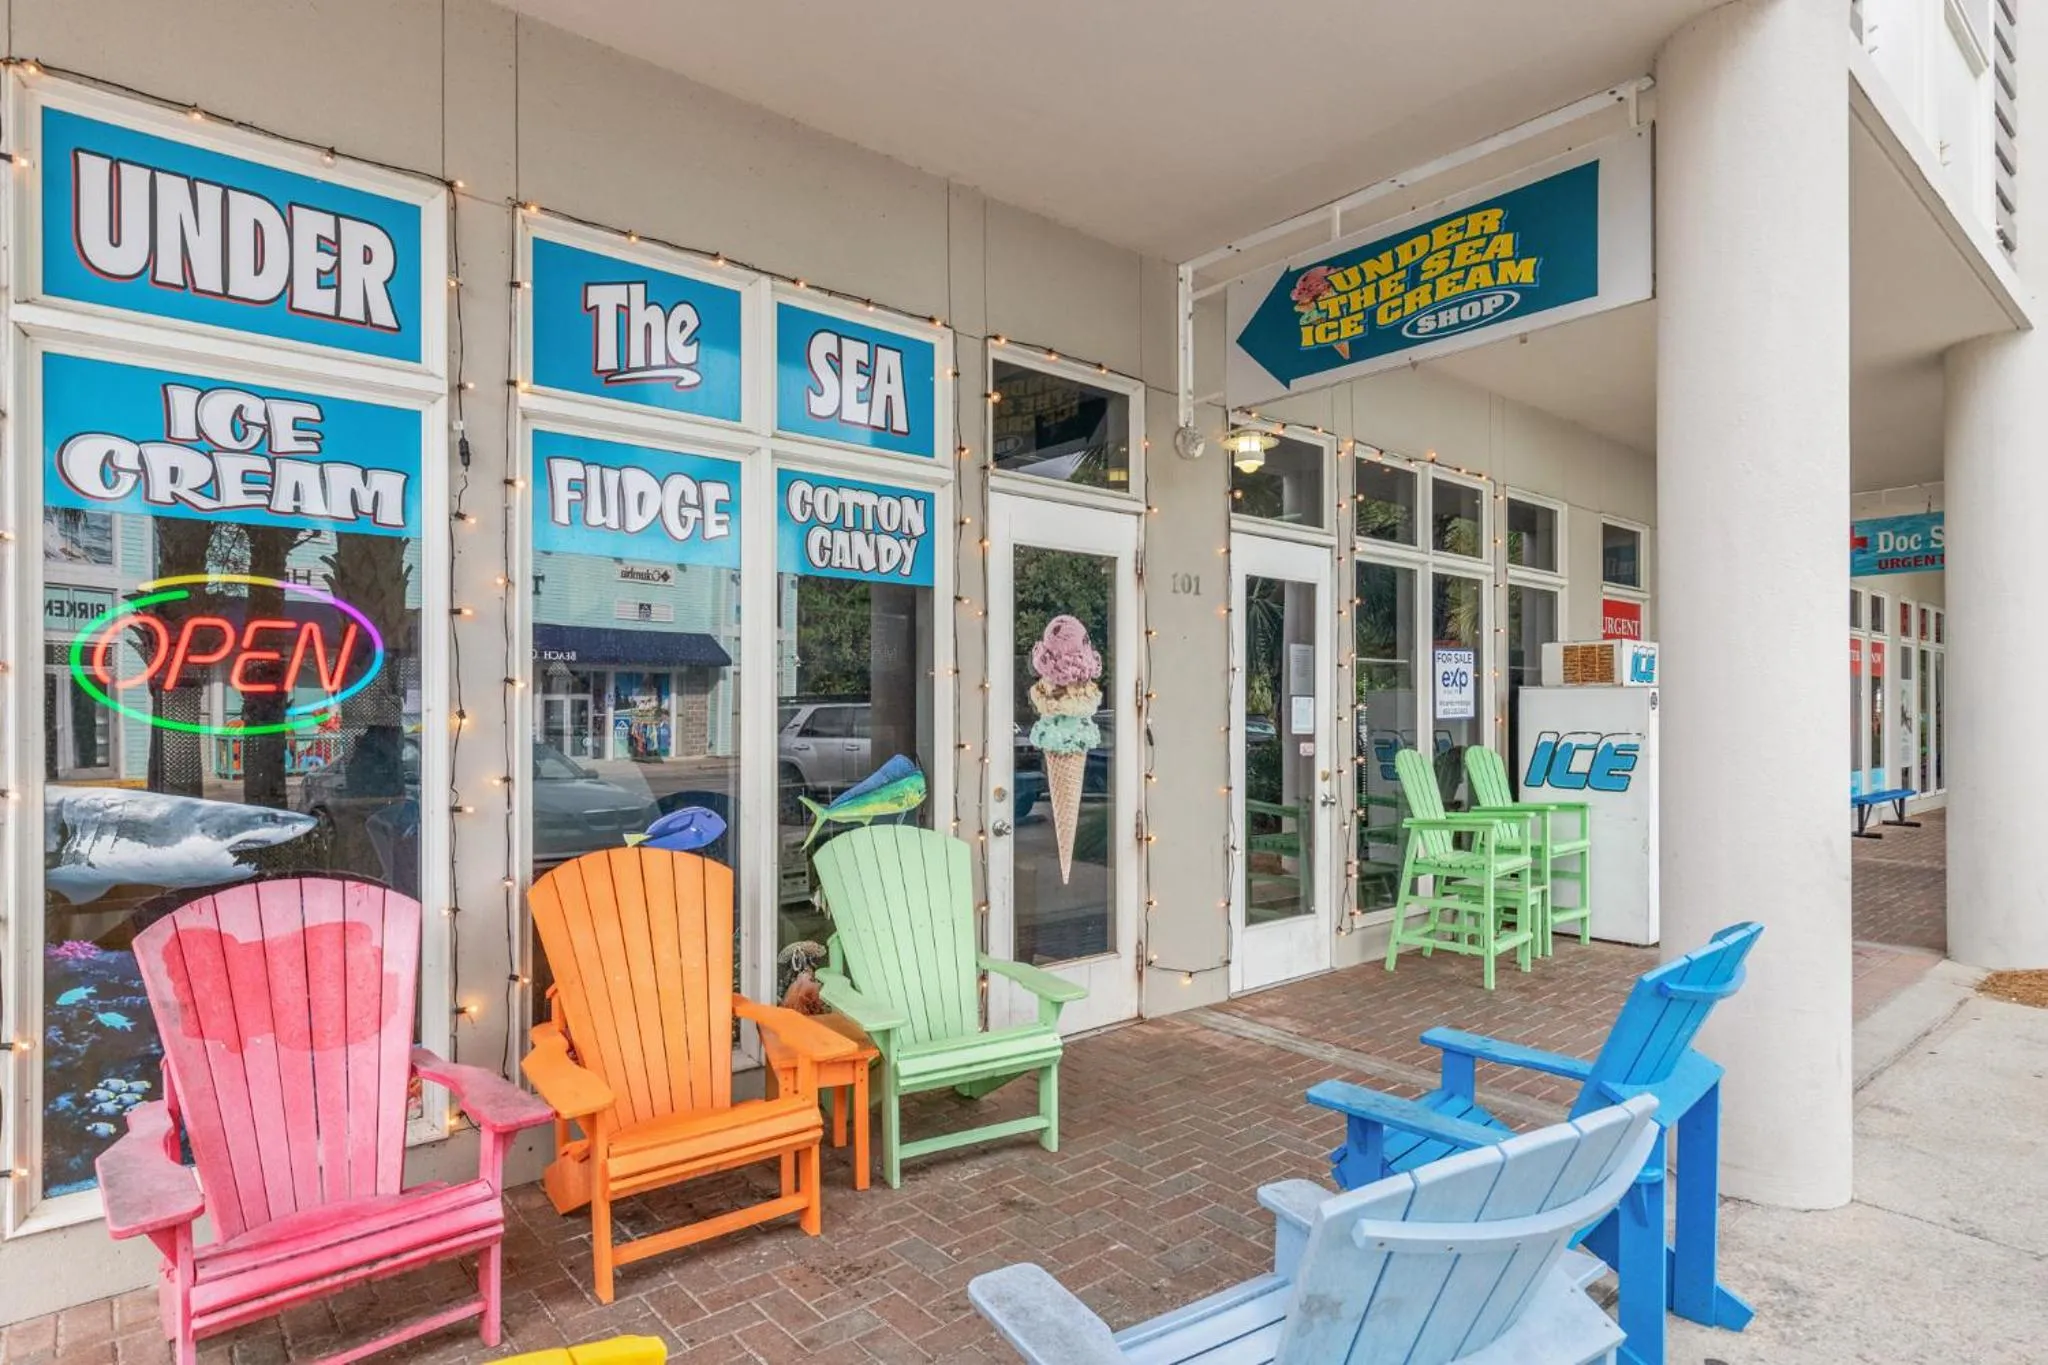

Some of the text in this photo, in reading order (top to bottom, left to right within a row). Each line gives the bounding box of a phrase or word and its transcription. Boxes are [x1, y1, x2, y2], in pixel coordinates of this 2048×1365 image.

[72, 147, 401, 333] UNDER
[1319, 231, 1519, 319] THE SEA
[1327, 208, 1508, 293] UNDER
[582, 280, 702, 378] The
[1300, 257, 1541, 349] ICE CREAM
[1416, 294, 1506, 334] SHOP
[806, 328, 910, 435] SEA
[161, 383, 324, 455] ICE
[56, 432, 409, 526] CREAM
[546, 456, 732, 542] FUDGE
[786, 479, 928, 538] COTTON
[805, 525, 920, 578] CANDY
[1877, 530, 1922, 553] Doc
[1171, 572, 1203, 596] 101
[93, 614, 358, 692] OPEN
[1437, 652, 1473, 664] FOR SALE
[1441, 667, 1468, 694] exp
[1630, 644, 1657, 684] ICE
[1524, 731, 1645, 792] ICE
